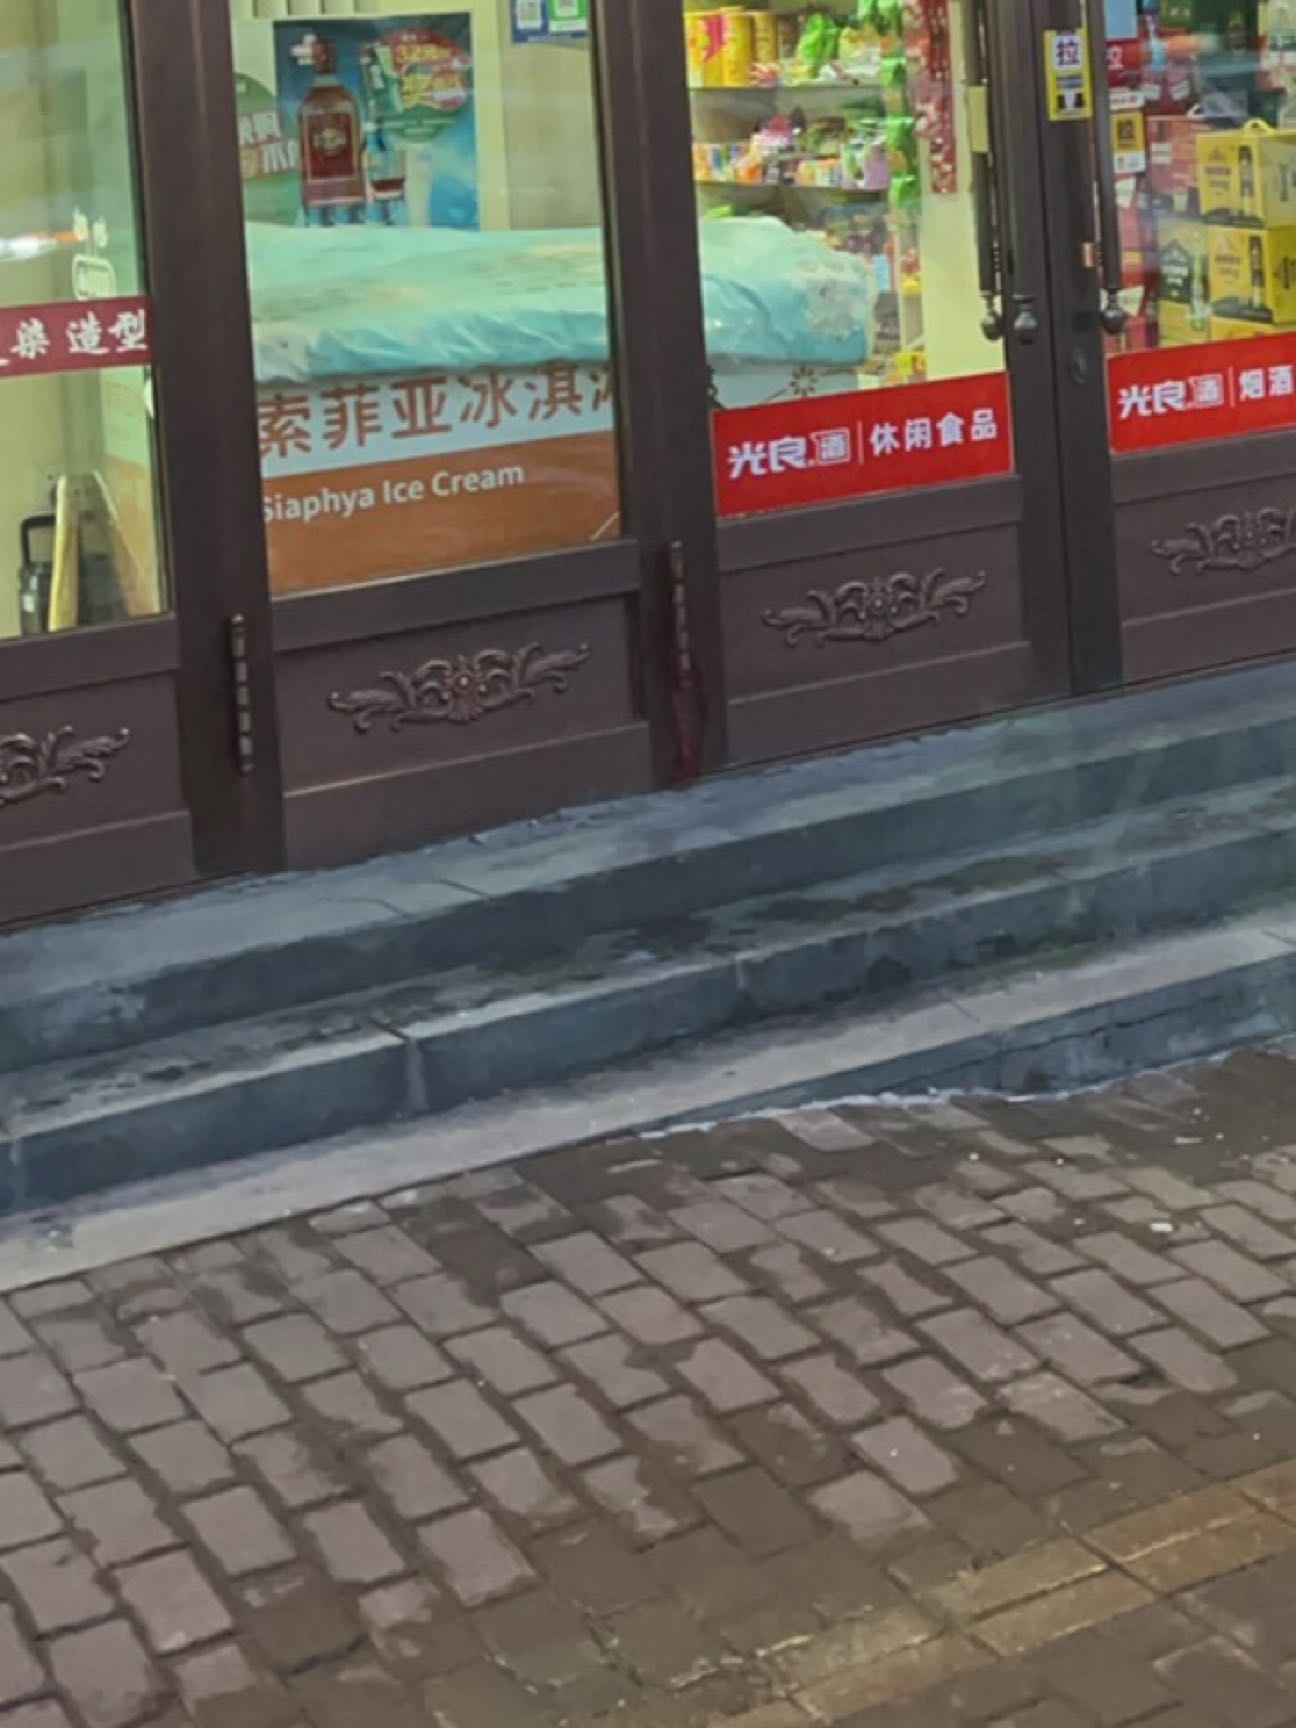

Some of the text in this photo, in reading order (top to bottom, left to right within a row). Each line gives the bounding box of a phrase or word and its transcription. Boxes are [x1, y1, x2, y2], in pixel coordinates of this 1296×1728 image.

[0, 308, 148, 366] 染造型
[869, 407, 998, 457] 休闲食品
[383, 479, 424, 505] Ice
[431, 465, 526, 497] Cream
